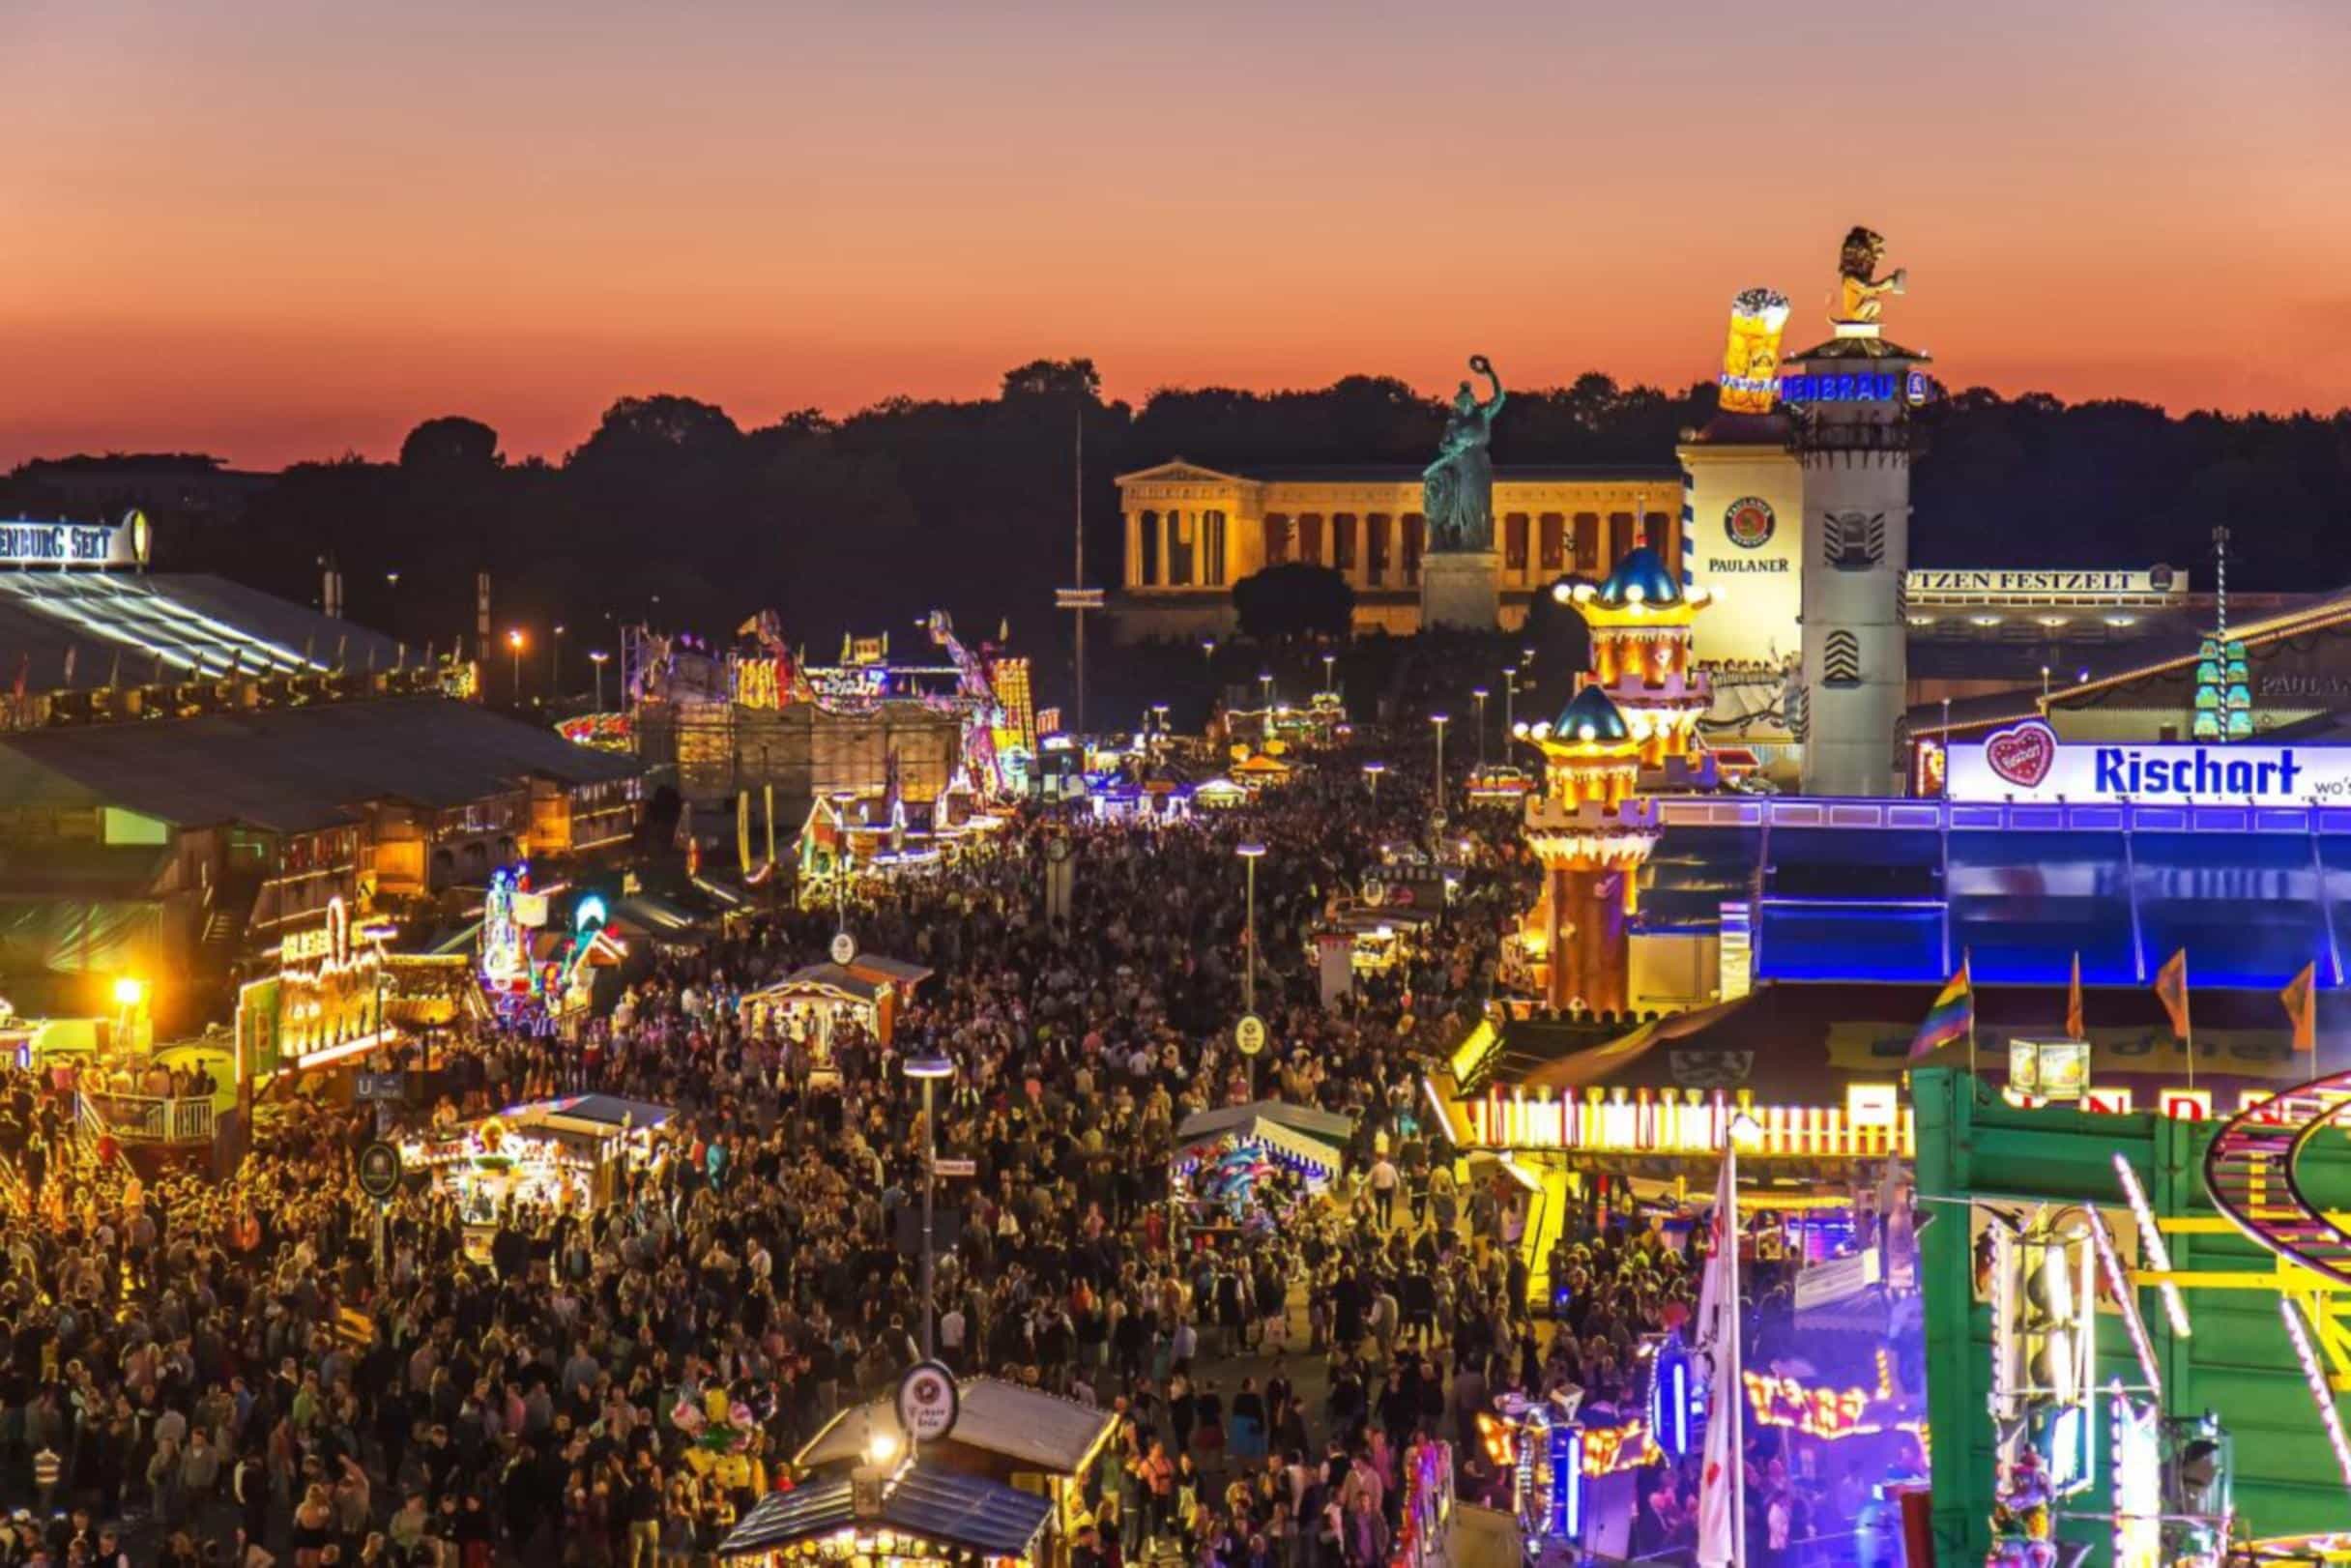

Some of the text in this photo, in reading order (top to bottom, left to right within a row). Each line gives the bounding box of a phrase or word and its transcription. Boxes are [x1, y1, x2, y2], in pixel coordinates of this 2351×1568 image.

[1709, 558, 1789, 572] PAULANER
[1908, 572, 2134, 590] TZEN FESTZELT
[2096, 748, 2302, 795] Rischart
[359, 1079, 371, 1095] U
